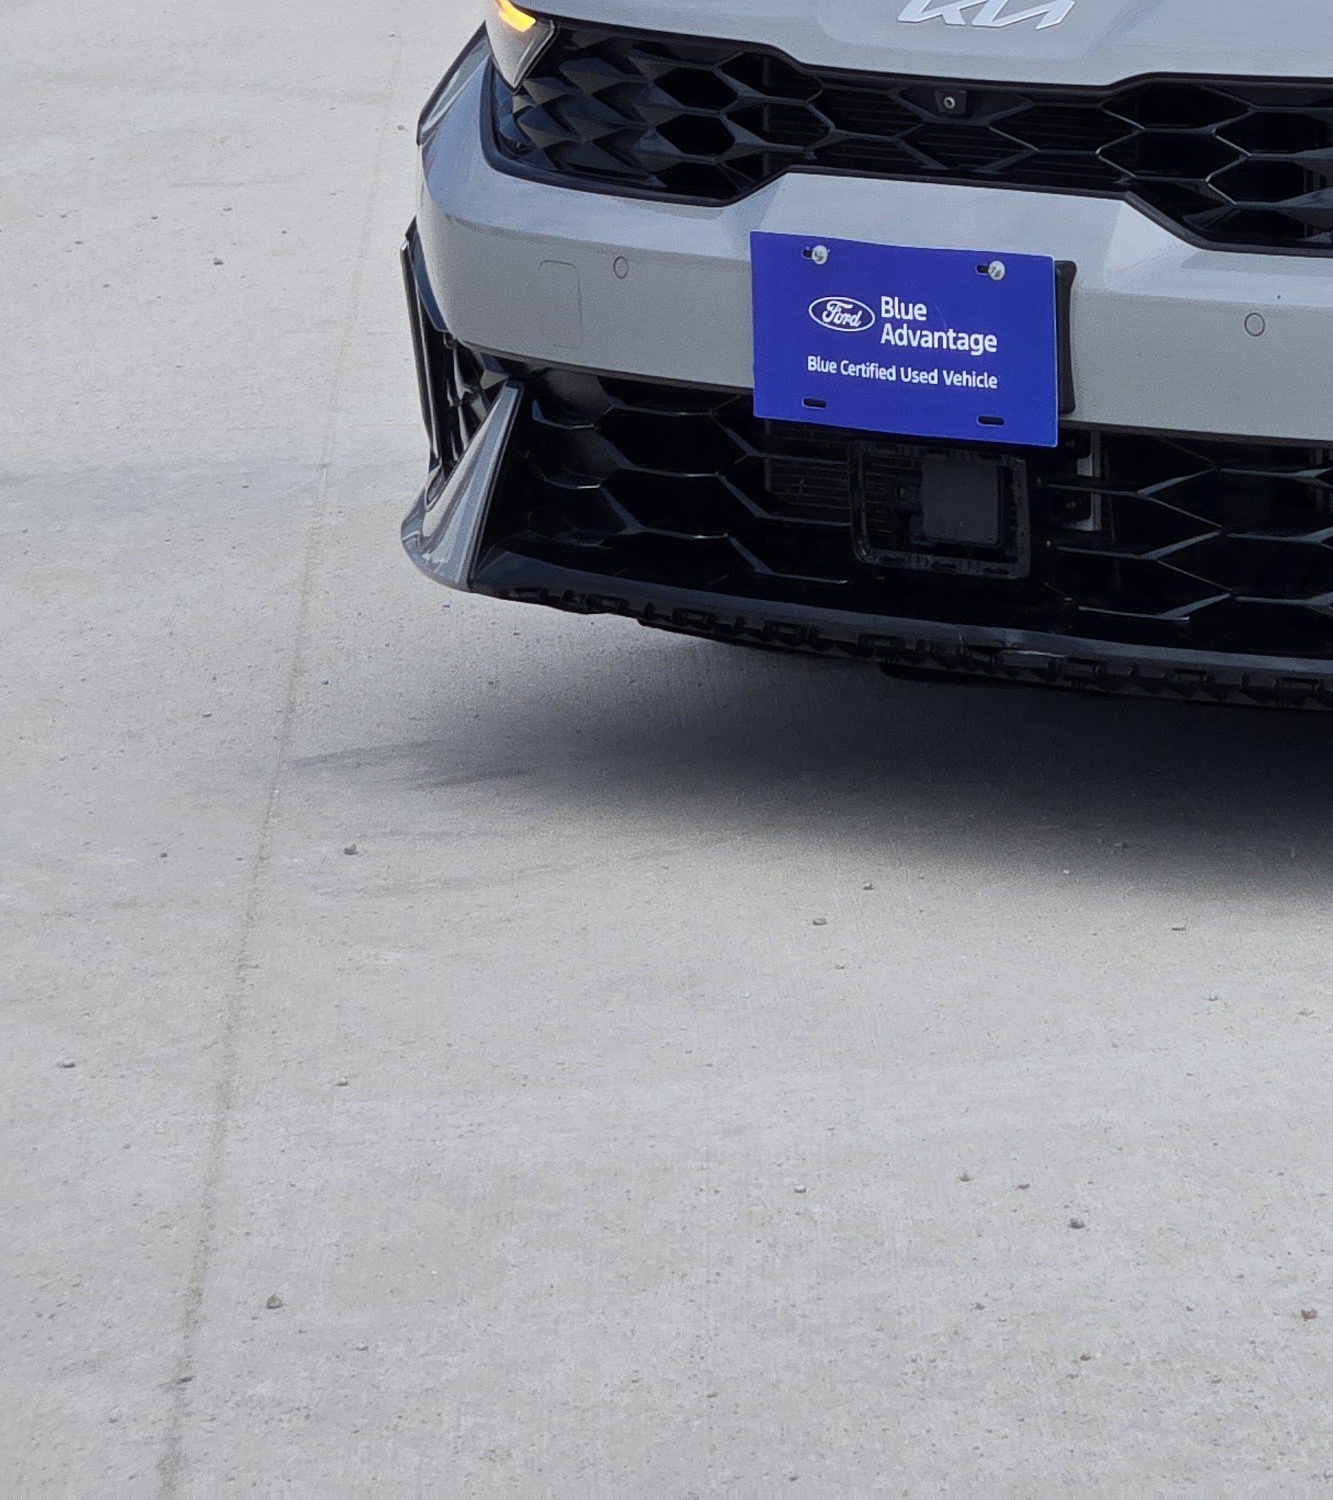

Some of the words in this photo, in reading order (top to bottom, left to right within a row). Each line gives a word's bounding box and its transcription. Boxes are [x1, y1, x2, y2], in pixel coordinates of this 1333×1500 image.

[822, 300, 863, 328] Ford
[881, 296, 927, 321] Blue
[880, 323, 997, 356] Advantage
[808, 355, 837, 374] Blue
[840, 360, 897, 381] Certified
[900, 366, 938, 385] Used
[942, 370, 998, 389] Vehicle
